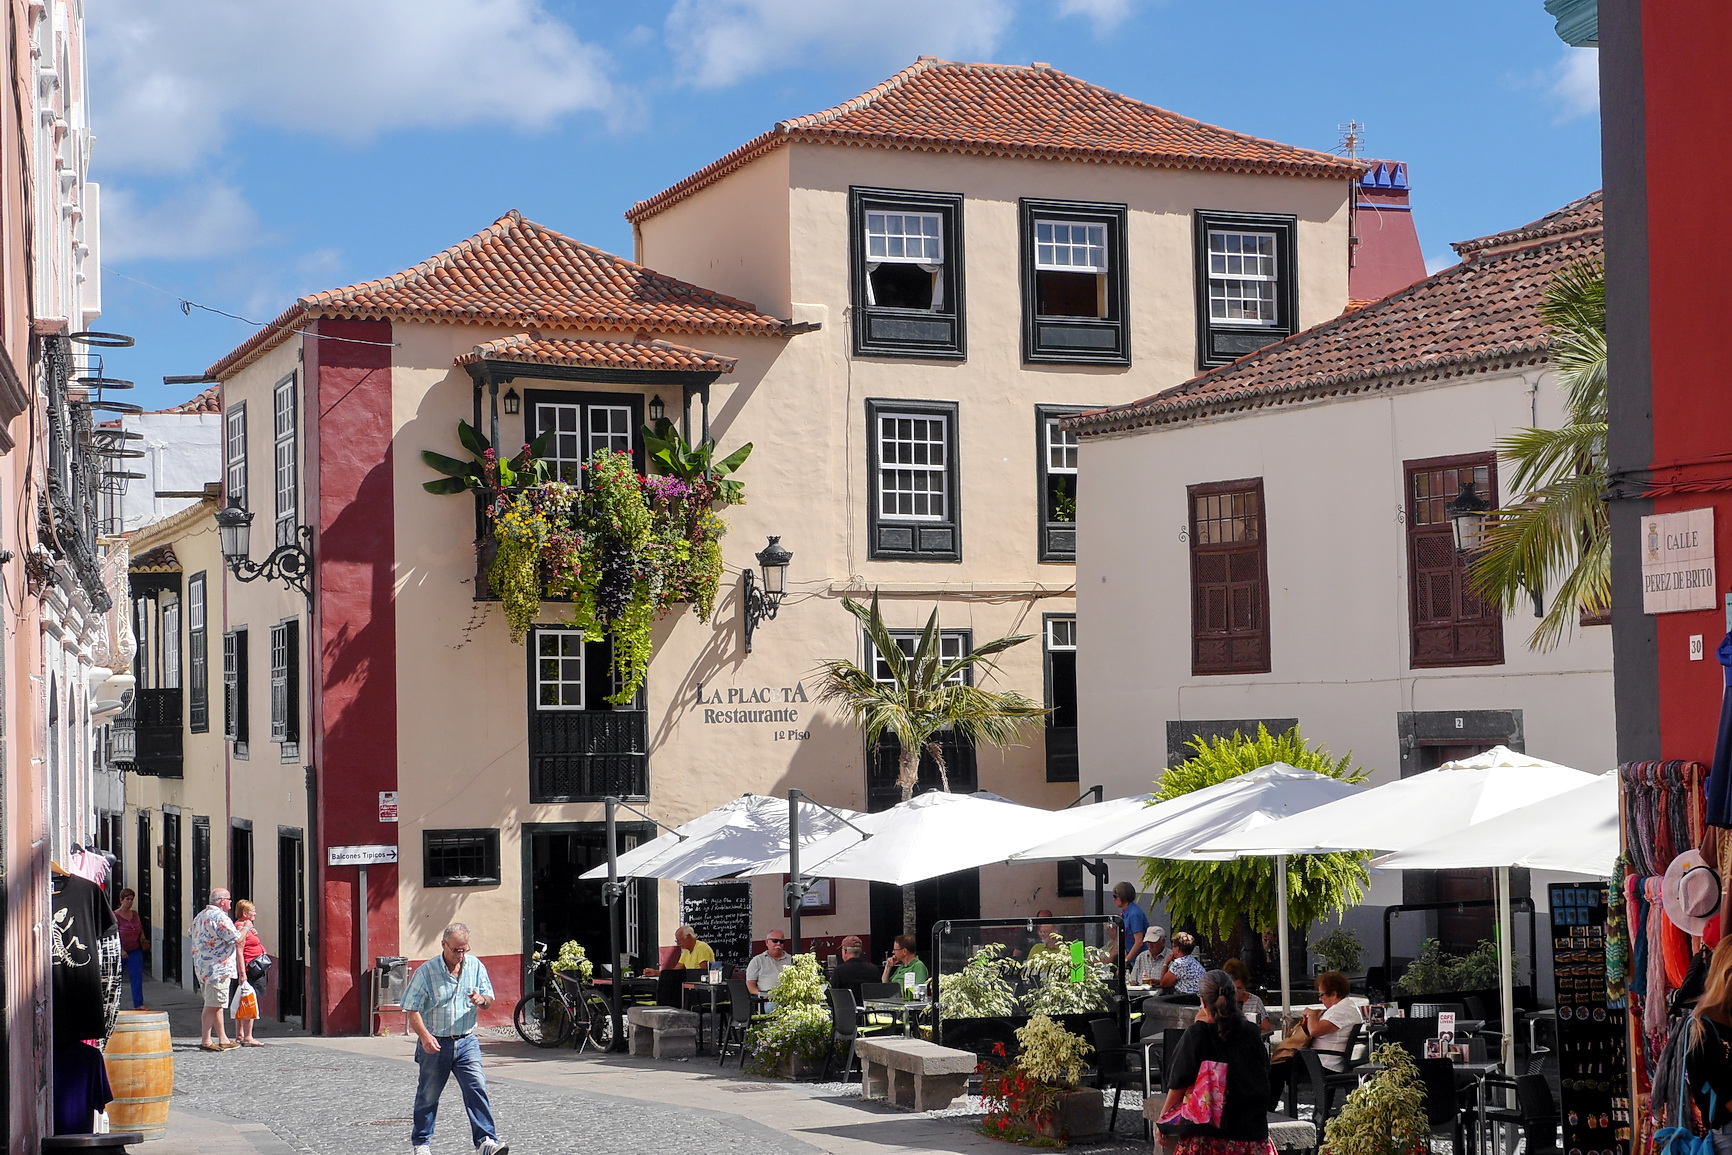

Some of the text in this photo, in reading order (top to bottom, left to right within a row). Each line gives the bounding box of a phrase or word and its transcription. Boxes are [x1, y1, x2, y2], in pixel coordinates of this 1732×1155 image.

[1667, 531, 1698, 550] CALLE
[1645, 568, 1713, 593] PEREZ DE BRITO
[1691, 640, 1702, 654] 30
[696, 682, 723, 704] LA
[704, 707, 799, 724] Restaurante
[1456, 719, 1462, 727] 2
[788, 729, 811, 741] Piso
